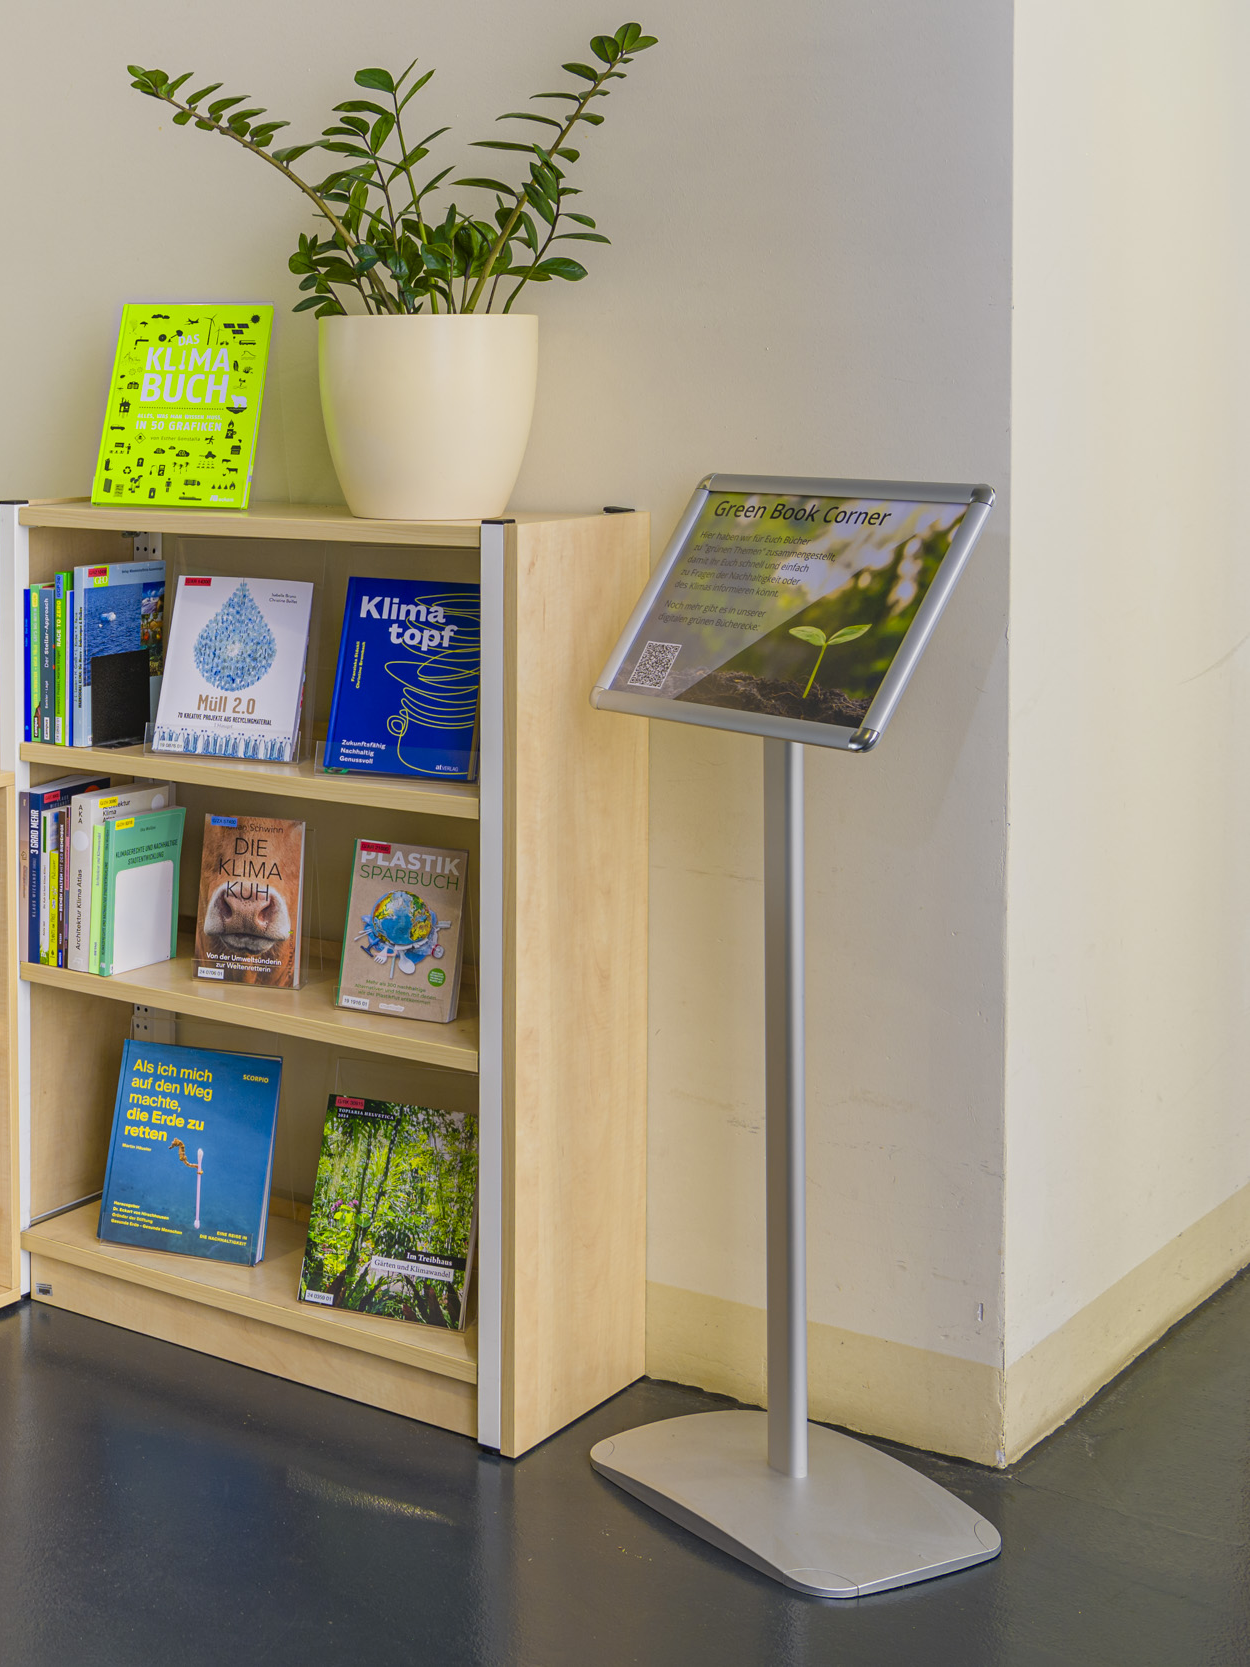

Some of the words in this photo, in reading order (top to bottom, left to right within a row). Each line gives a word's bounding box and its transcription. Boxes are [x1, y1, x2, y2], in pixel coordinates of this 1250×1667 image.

[178, 334, 200, 346] DAS
[146, 347, 230, 371] KLIMA
[140, 373, 229, 403] BUCH
[136, 421, 147, 429] IN
[151, 421, 164, 430] 50
[169, 421, 222, 431] GRAFIKEN
[714, 500, 767, 519] Green
[770, 503, 820, 523] Book
[824, 506, 891, 527] Corner
[700, 531, 714, 540] Hier
[717, 532, 739, 541] haben
[753, 534, 763, 543] für
[764, 535, 782, 544] Euch
[784, 536, 811, 545] Bücher
[688, 555, 708, 564] damit
[710, 557, 719, 566] Ihr
[720, 558, 737, 567] Euch
[739, 559, 764, 569] schnell
[765, 561, 779, 570] und
[781, 561, 809, 573] einfach
[766, 549, 836, 562] zusammengestellt,
[691, 569, 715, 579] Fragen
[717, 571, 728, 579] der
[730, 571, 781, 584] Nachhaltigkeit
[782, 576, 800, 586] oder
[360, 595, 446, 623] Klima
[56, 619, 61, 628] TO
[389, 623, 458, 651] topf
[197, 694, 227, 713] Müll
[232, 697, 256, 715] 2.0
[340, 747, 374, 757] Nachhaltig
[342, 739, 386, 750] Zukunftsfähig
[339, 755, 373, 764] Genussvoll
[30, 809, 39, 828] MEHR
[250, 823, 283, 833] Schwinn
[31, 829, 39, 848] GRAD
[235, 837, 268, 857] DIE
[218, 858, 282, 880] KLIMA
[360, 850, 461, 876] PLASTIK
[360, 864, 459, 891] SPARBUCH
[226, 880, 269, 902] KUH
[206, 952, 218, 960] Von
[231, 954, 282, 966] Umweltsünderin
[227, 962, 271, 973] Weltenretterin
[133, 1059, 154, 1073] Als
[157, 1062, 178, 1077] ich
[180, 1065, 213, 1082] mich
[243, 1074, 269, 1084] SCORPIO
[131, 1076, 153, 1089] auf
[155, 1079, 180, 1094] den
[183, 1083, 213, 1102] Weg
[129, 1092, 181, 1113] machte,
[127, 1108, 149, 1122] die
[151, 1111, 185, 1128] Erde
[187, 1117, 205, 1131] zu
[124, 1125, 168, 1141] retten
[374, 1258, 396, 1270] Gärten
[397, 1263, 409, 1272] und
[409, 1264, 451, 1279] Klimawandel
[406, 1252, 417, 1261] Im
[418, 1253, 453, 1267] Treibhaus
